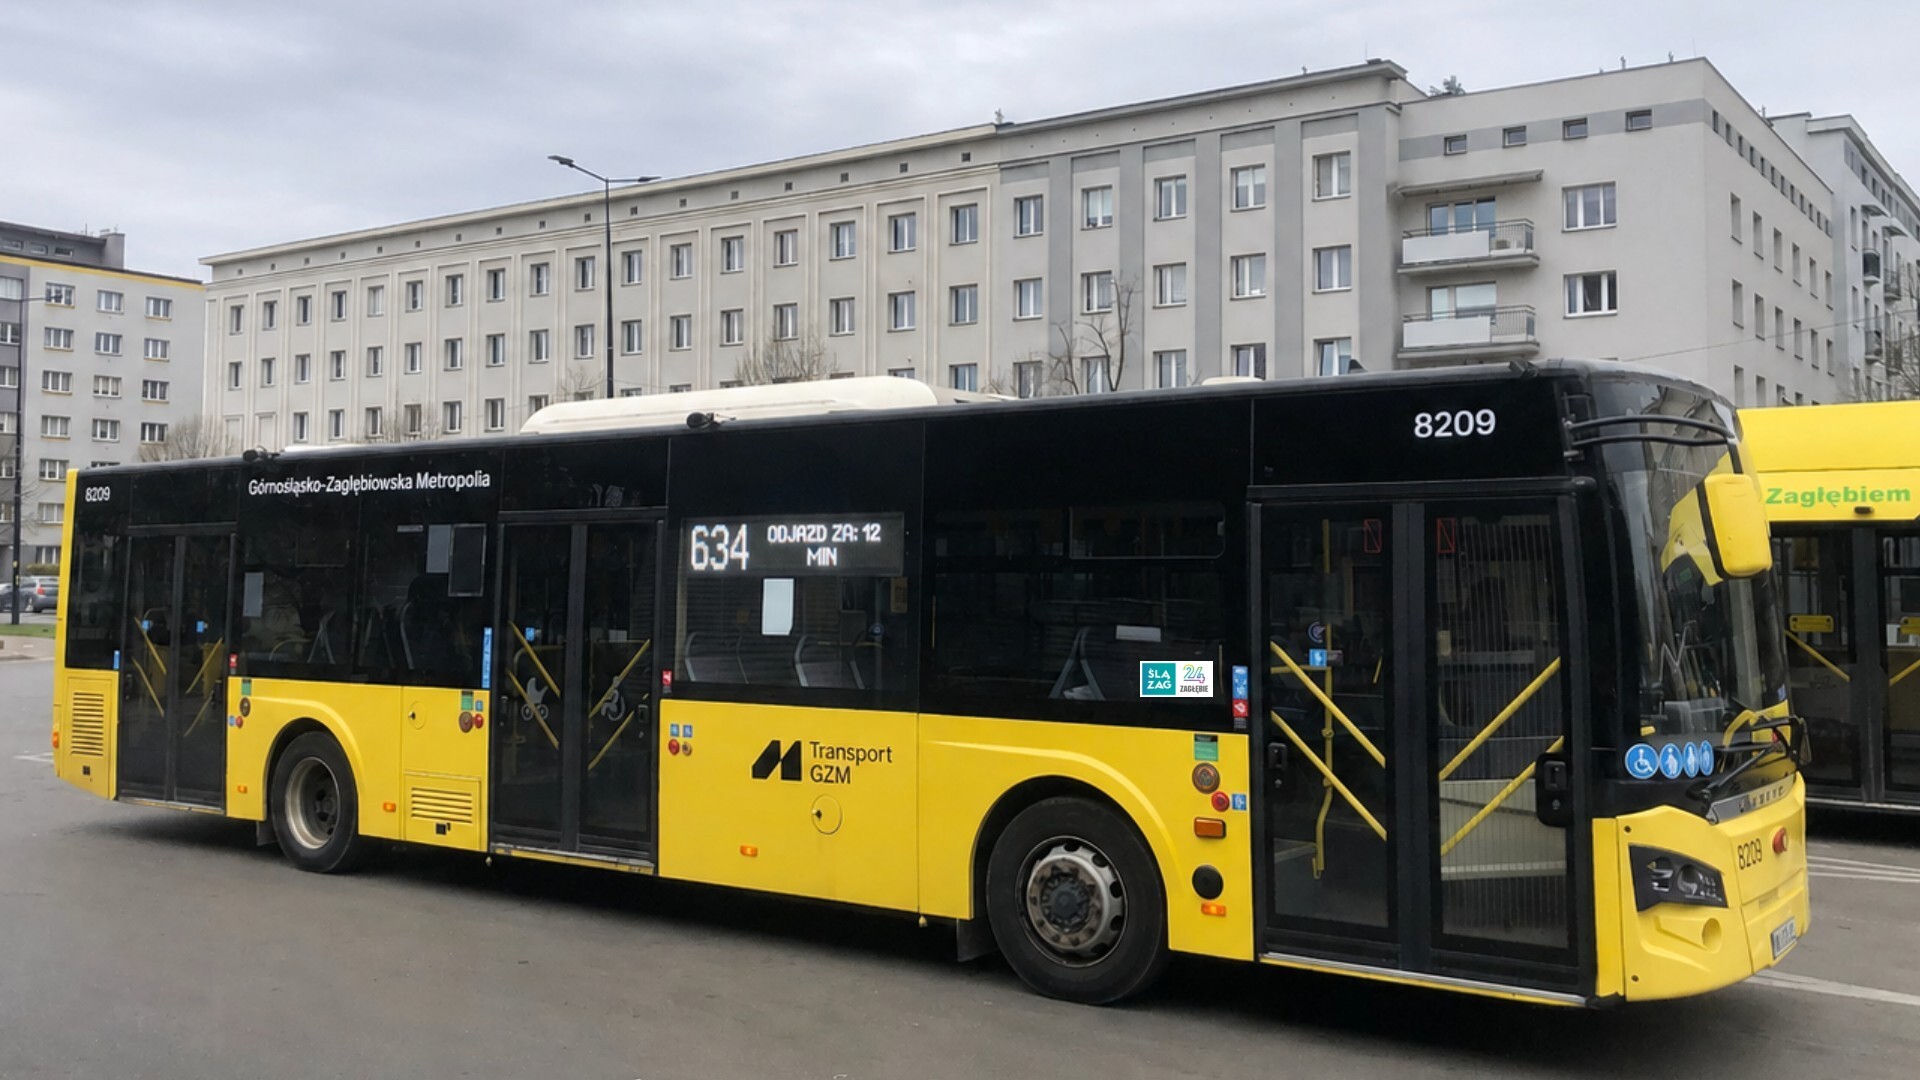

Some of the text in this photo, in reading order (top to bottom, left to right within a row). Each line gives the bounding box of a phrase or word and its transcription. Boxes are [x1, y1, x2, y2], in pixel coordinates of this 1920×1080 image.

[1414, 408, 1496, 438] 8209
[416, 470, 491, 492] Metropolia
[85, 486, 111, 502] 8209
[767, 523, 881, 543] ODJAZD ZA: 12
[690, 523, 749, 571] 634
[806, 547, 838, 567] MIN
[809, 741, 892, 766] Transport
[810, 764, 851, 785] GZM
